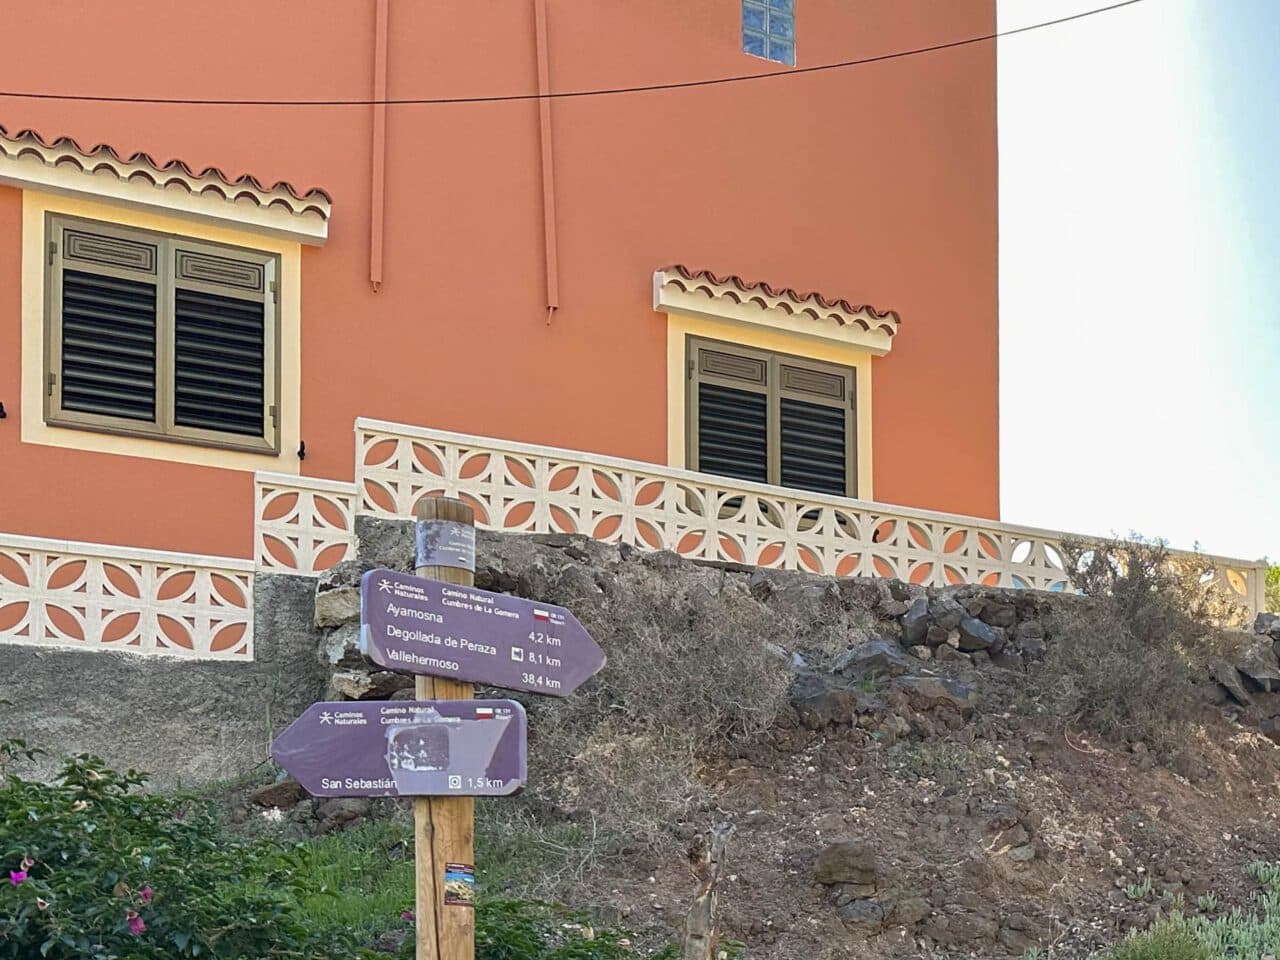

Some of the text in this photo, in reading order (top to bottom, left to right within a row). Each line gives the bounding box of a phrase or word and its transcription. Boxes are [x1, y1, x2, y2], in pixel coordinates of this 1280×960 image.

[394, 581, 425, 594] Caminos
[394, 589, 429, 602] Naturales
[441, 587, 495, 605] Camino Natural
[386, 602, 444, 624] Ayamosna
[441, 597, 520, 620] Cumbres de La Gomera
[386, 624, 497, 656] Degollada de Peraza
[528, 631, 561, 647] 4,2 km
[386, 647, 459, 671] Vallehermoso
[528, 652, 561, 667] 8,1 km
[521, 672, 561, 689] 38,4 km
[380, 705, 434, 714] Camino Natural
[380, 716, 412, 724] Cumbres
[321, 777, 398, 789] San Sebastián
[467, 776, 503, 789] 1,5 km
